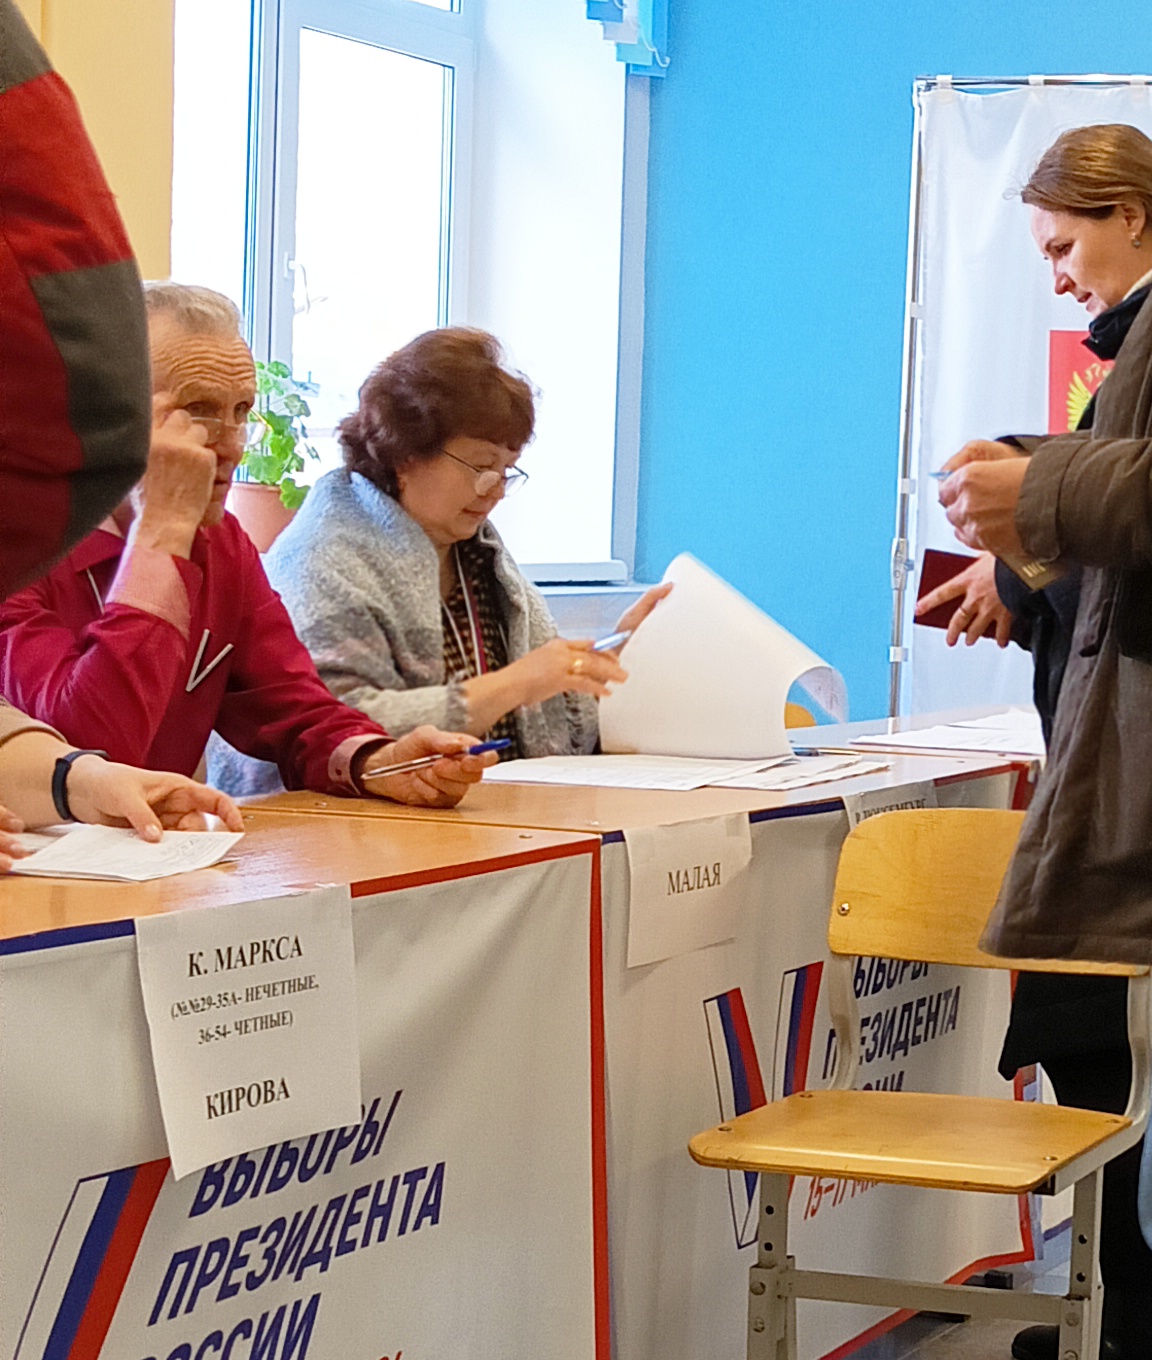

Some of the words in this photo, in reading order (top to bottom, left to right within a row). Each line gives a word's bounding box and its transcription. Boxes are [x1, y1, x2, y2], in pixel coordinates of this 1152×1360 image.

[667, 862, 722, 896] МАЛАЯ
[188, 952, 208, 977] К.
[214, 935, 303, 973] МАРКСА
[198, 1023, 232, 1045] 36-54-
[234, 1010, 294, 1037] ЧЕТНЫЕ)
[823, 985, 961, 1080] ПЕЗИДЕНТА
[206, 1077, 291, 1120] КИРОВА
[147, 1161, 446, 1327] ПРЕЗИДЕНТА
